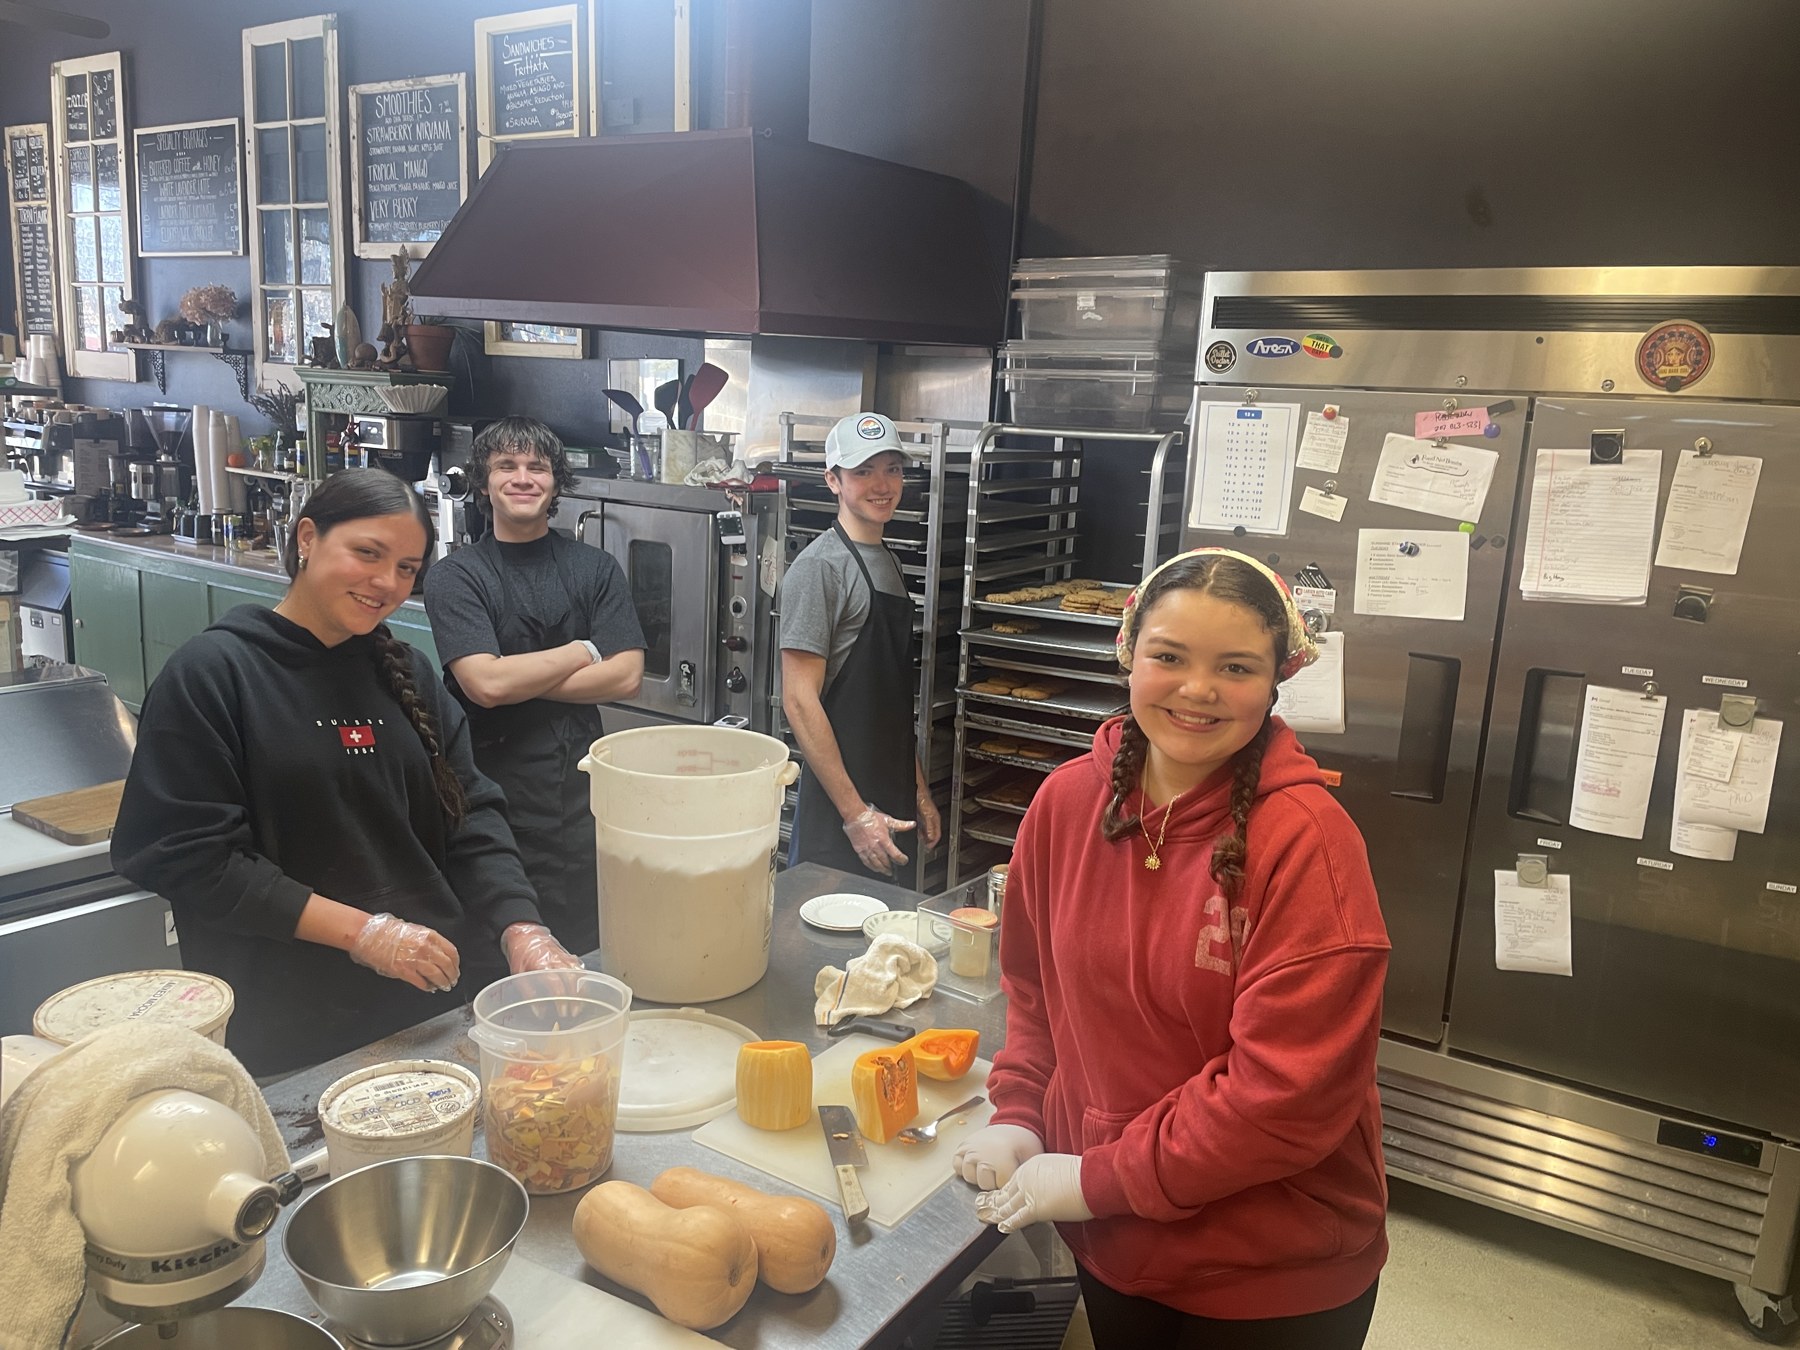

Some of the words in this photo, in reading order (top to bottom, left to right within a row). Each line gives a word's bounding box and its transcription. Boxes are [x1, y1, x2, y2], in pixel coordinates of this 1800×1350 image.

[503, 35, 554, 59] SANDWICHES
[376, 89, 431, 118] SMOOTHIES
[367, 123, 412, 144] STRAWBERRY
[416, 120, 451, 140] NIRVANA
[368, 162, 399, 182] TROPICAL
[404, 158, 428, 179] MANGO
[370, 199, 389, 222] VERY
[393, 196, 418, 218] BERRY
[1311, 340, 1329, 351] THAT
